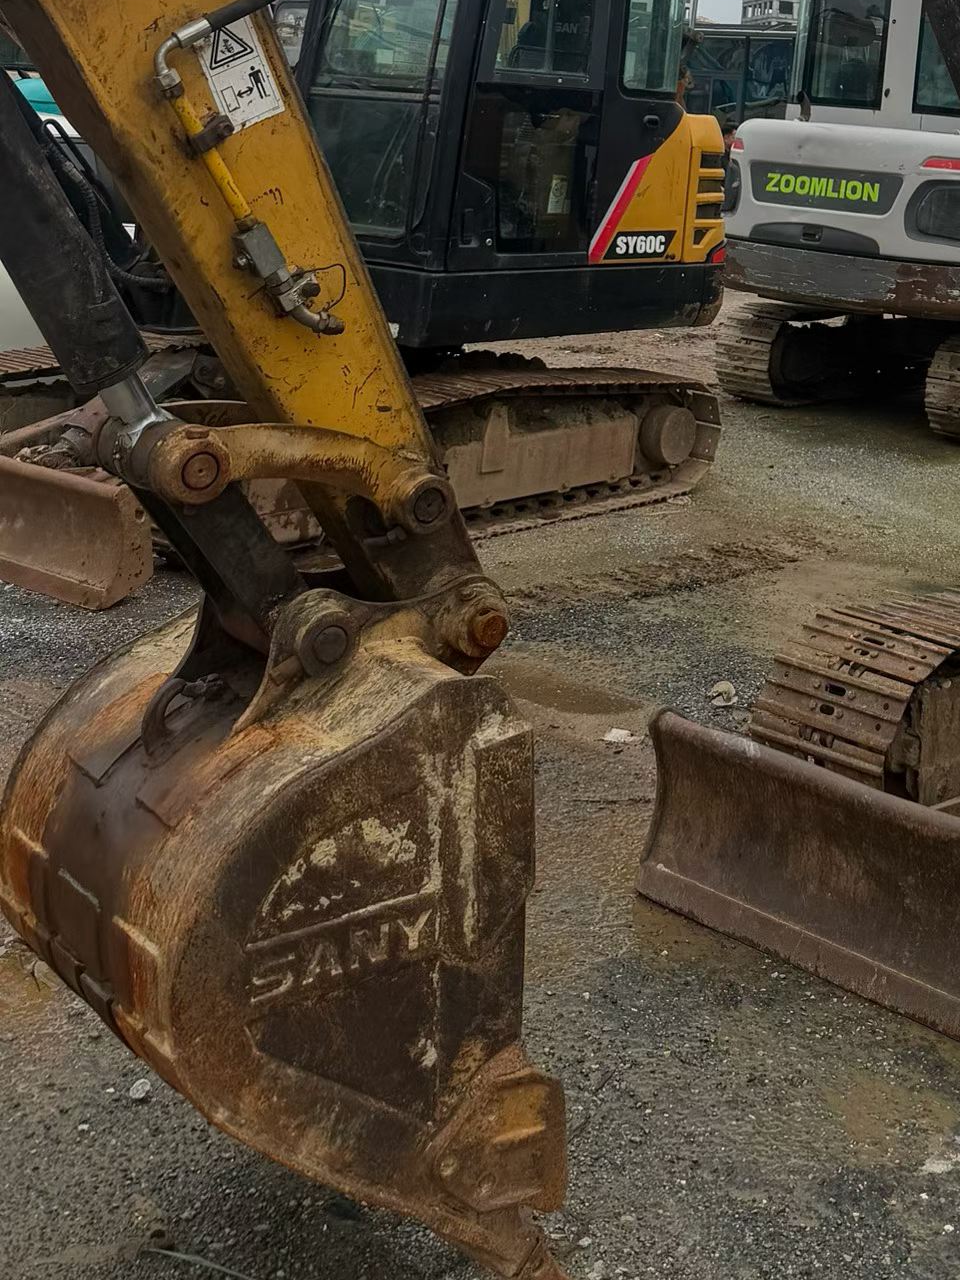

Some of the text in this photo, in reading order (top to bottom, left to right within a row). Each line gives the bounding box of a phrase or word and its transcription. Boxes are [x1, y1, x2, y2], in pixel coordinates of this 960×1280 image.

[554, 22, 582, 34] SAN
[765, 172, 880, 203] ZOOMLION
[615, 235, 666, 254] SY60C
[248, 908, 433, 1004] SANY
